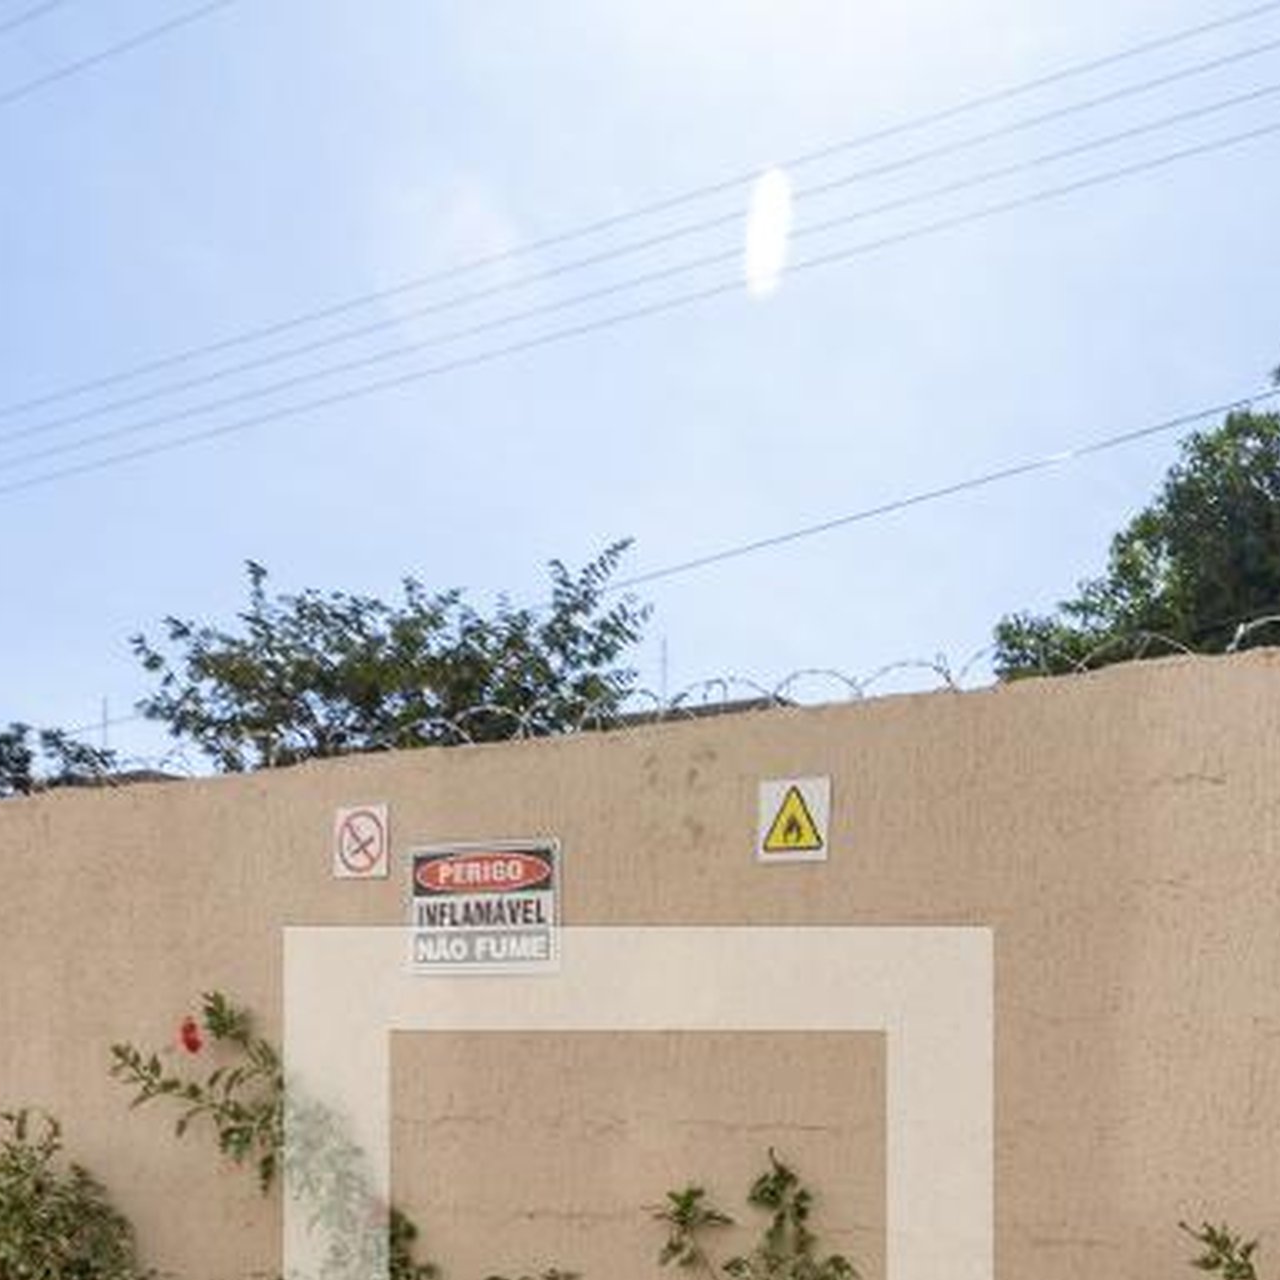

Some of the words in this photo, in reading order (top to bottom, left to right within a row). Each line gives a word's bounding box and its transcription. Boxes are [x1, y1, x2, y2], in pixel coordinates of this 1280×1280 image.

[439, 860, 523, 884] PERIGO
[419, 897, 545, 926] INFLAMÁVEL
[475, 936, 548, 960] FUME
